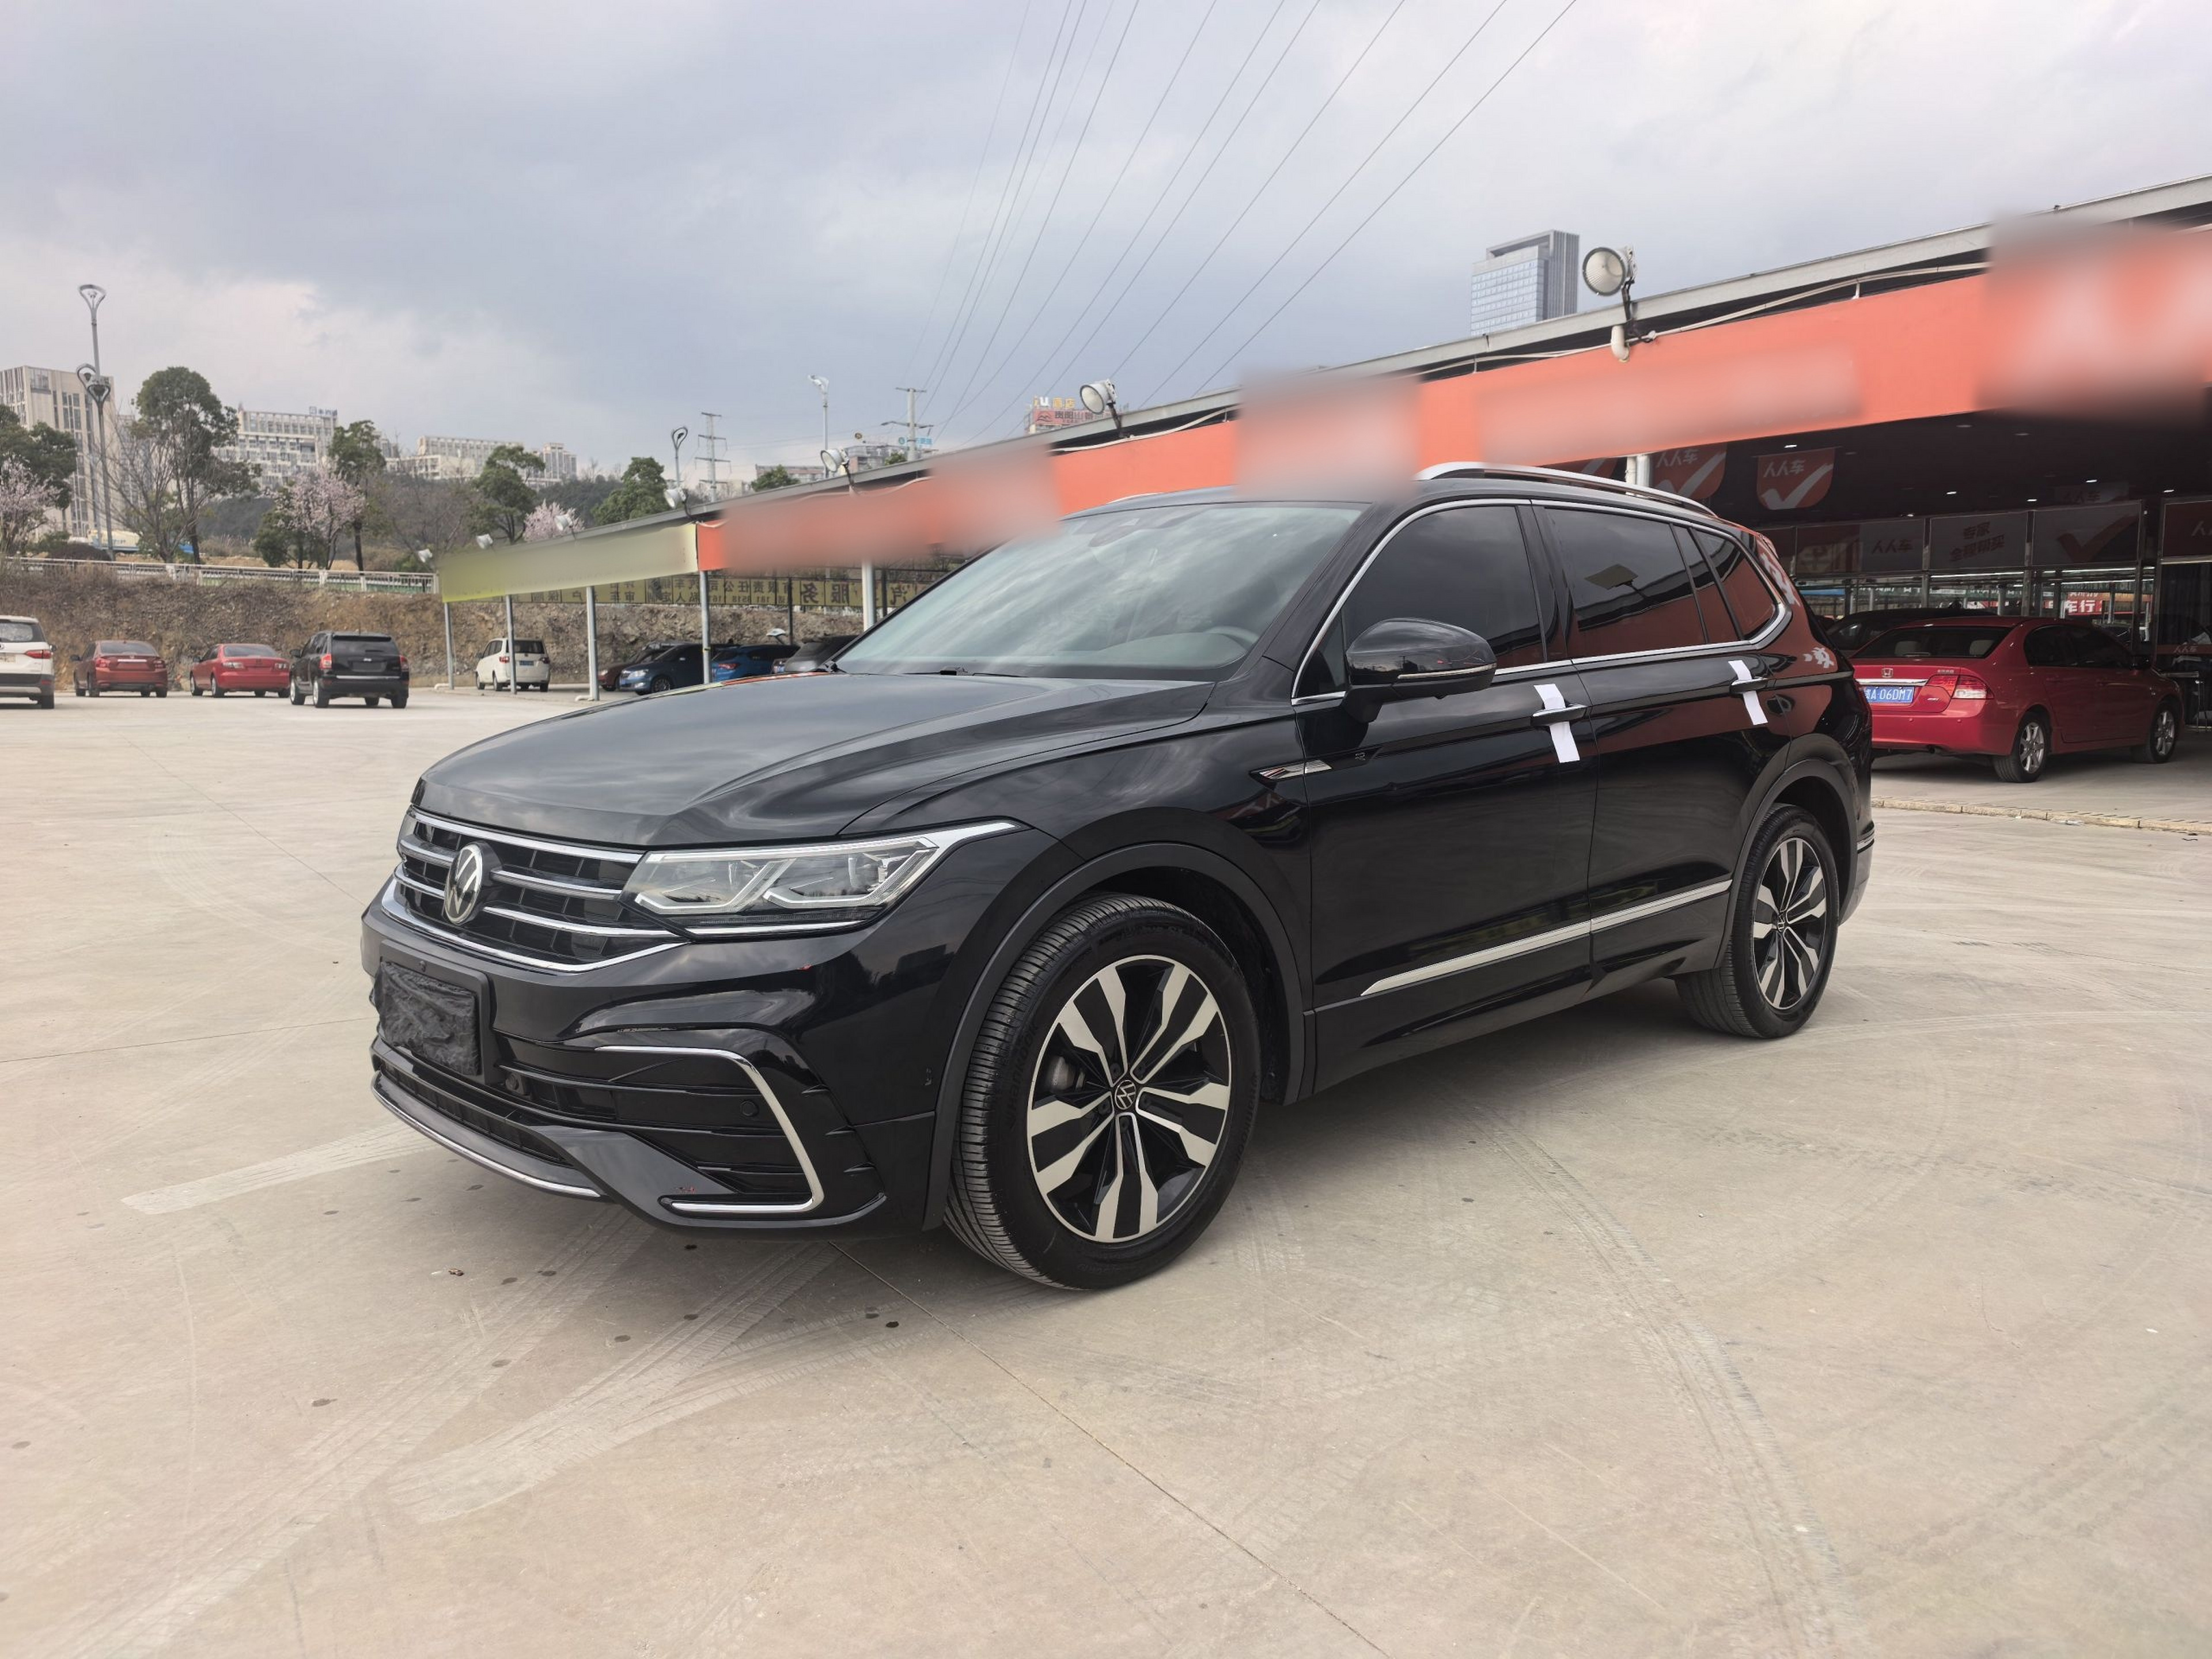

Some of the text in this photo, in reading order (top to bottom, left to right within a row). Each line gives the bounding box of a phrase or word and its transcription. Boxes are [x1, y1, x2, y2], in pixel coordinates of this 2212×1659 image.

[1656, 449, 1699, 468] 人人车
[1763, 459, 1805, 478] 人人车
[1872, 539, 1914, 554] 人人车
[2066, 600, 2103, 613] 车行
